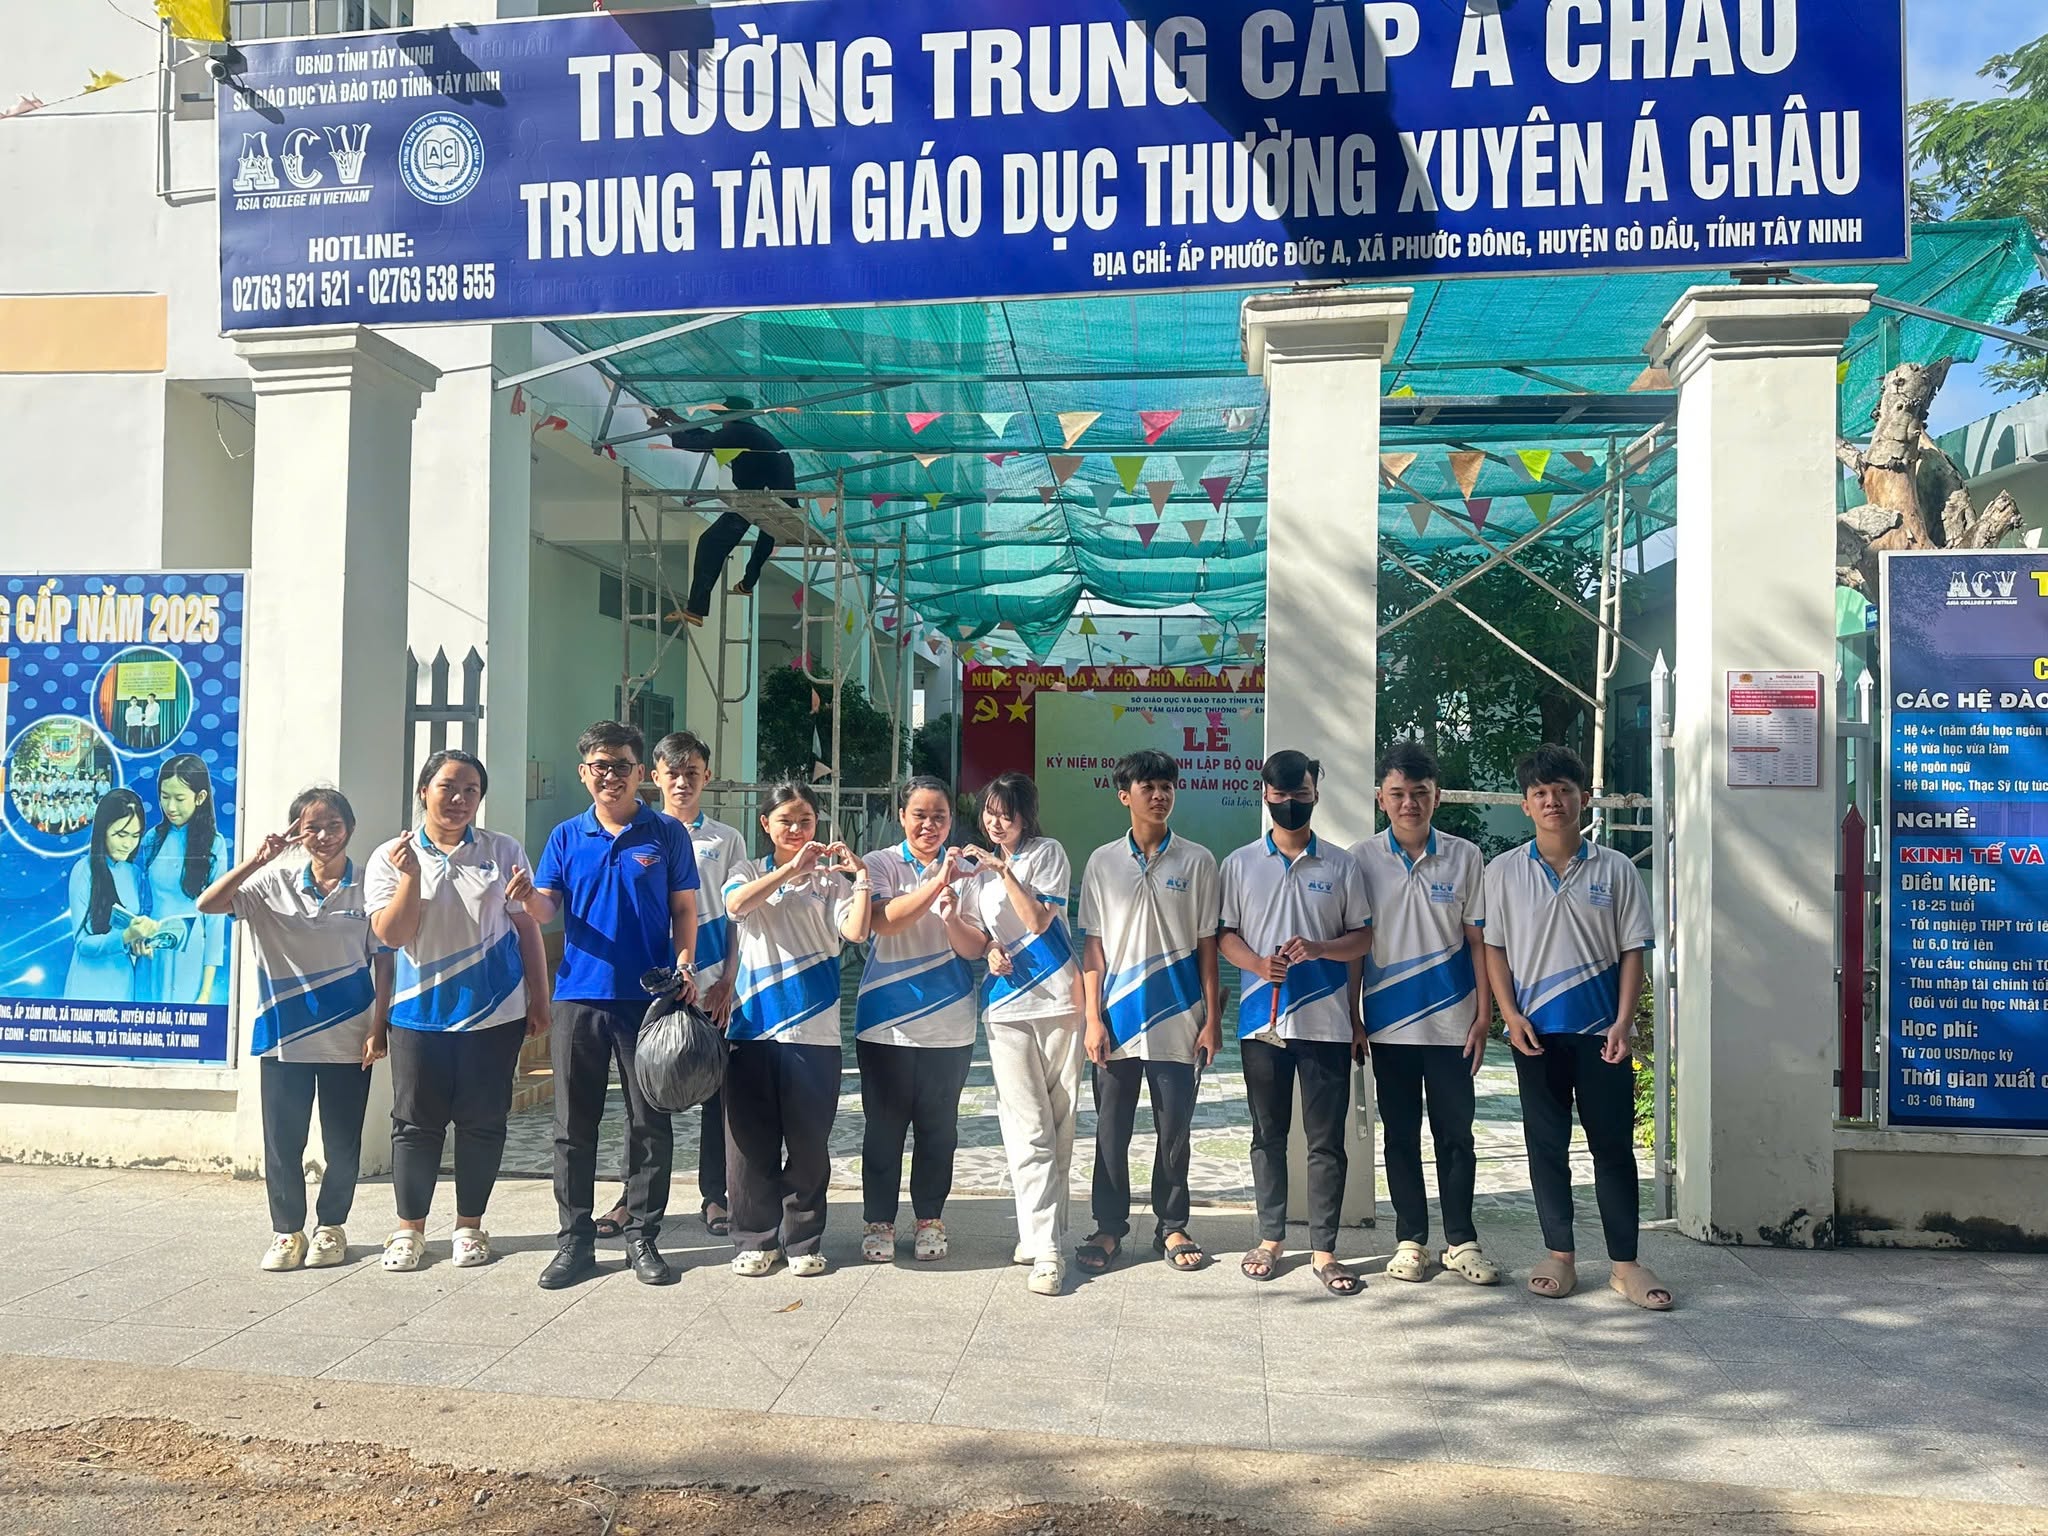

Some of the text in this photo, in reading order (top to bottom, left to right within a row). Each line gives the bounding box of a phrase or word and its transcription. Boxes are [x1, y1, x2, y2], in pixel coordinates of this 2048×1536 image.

[296, 45, 433, 75] UBND TỈNH TÂY NINH
[567, 15, 1209, 142] TRƯỜNG TRUNG
[255, 85, 285, 108] GIÁO
[288, 85, 315, 109] DỤC
[319, 80, 336, 104] VÀ
[340, 78, 368, 102] ĐÀO
[371, 79, 397, 103] TẠO
[401, 71, 432, 97] TỈNH
[436, 70, 461, 94] TÂY
[465, 70, 500, 92] NINH
[233, 123, 372, 191] ACV
[520, 93, 1860, 260] TRUNG TÂM GIÁO DỤC THƯỜNG XUYÊN Á CHÂU
[236, 189, 370, 211] ASIA COLLEGE IN VIETNAM
[308, 232, 414, 263] HOTLINE:
[1093, 216, 1862, 281] ĐỊA CHỈ: ẤP PHƯỚC ĐỨC A, XÃ PHƯỚC ĐÔNG, HUYỆN GÒ DẦU, TỈNH TÂY NINH
[232, 274, 281, 313] 02763
[285, 271, 314, 309] 521
[321, 270, 350, 307] 521
[368, 266, 421, 305] 02763
[426, 264, 457, 302] 538
[463, 263, 495, 300] 555
[1947, 571, 2017, 598] ACV
[16, 578, 220, 643] CẤP NĂM 2025
[1896, 689, 1950, 709] CÁC
[1957, 688, 1992, 712] HỆ
[1904, 725, 1917, 738] Hệ
[1921, 725, 1935, 735] 4+
[1939, 725, 1966, 736] (năm
[1993, 725, 2012, 738] học
[2016, 725, 2042, 737] ngôn
[1904, 743, 1917, 756] Hệ
[1944, 743, 1963, 756] học
[1989, 744, 2009, 754] làm
[1101, 758, 1115, 768] 80
[1197, 756, 1220, 773] LẬP
[1224, 756, 1241, 773] BỘ
[1904, 761, 1971, 774] Hệ ngôn ngữ
[1191, 776, 1218, 789] NĂM
[1223, 780, 1248, 794] HỌC
[1904, 780, 1917, 793] Hệ
[1921, 780, 1938, 793] Đại
[1942, 780, 1965, 793] Học,
[1969, 780, 1994, 793] Thạc
[1897, 807, 1976, 828] NGHỀ:
[1900, 842, 2045, 864] KINH TẾ VÀ
[1902, 872, 1995, 895] Điều kiện:
[1911, 897, 1975, 911] 18-25 tuổi
[1910, 917, 1929, 930] Tốt
[1933, 919, 1976, 933] nghiệp
[1981, 920, 2012, 931] THPT
[1929, 938, 1948, 951] 6,0
[1974, 939, 1993, 951] lên
[1910, 957, 2008, 972] Yêu chứng
[1910, 977, 2028, 991] Thu nhập tài chính
[1909, 995, 1934, 1009] (Đối
[1939, 997, 1957, 1009] với
[1962, 998, 1977, 1009] du
[1982, 998, 2006, 1013] học
[2009, 999, 2039, 1012] Nhật
[189, 1012, 207, 1026] NINH
[1901, 1020, 1978, 1040] Học phí:
[181, 1034, 199, 1047] NINH
[1919, 1048, 1941, 1059] 700
[1945, 1048, 1995, 1062] USD/học
[1901, 1068, 2035, 1088] Thời gian xuất
[1908, 1094, 1975, 1109] 03 06 Tháng
